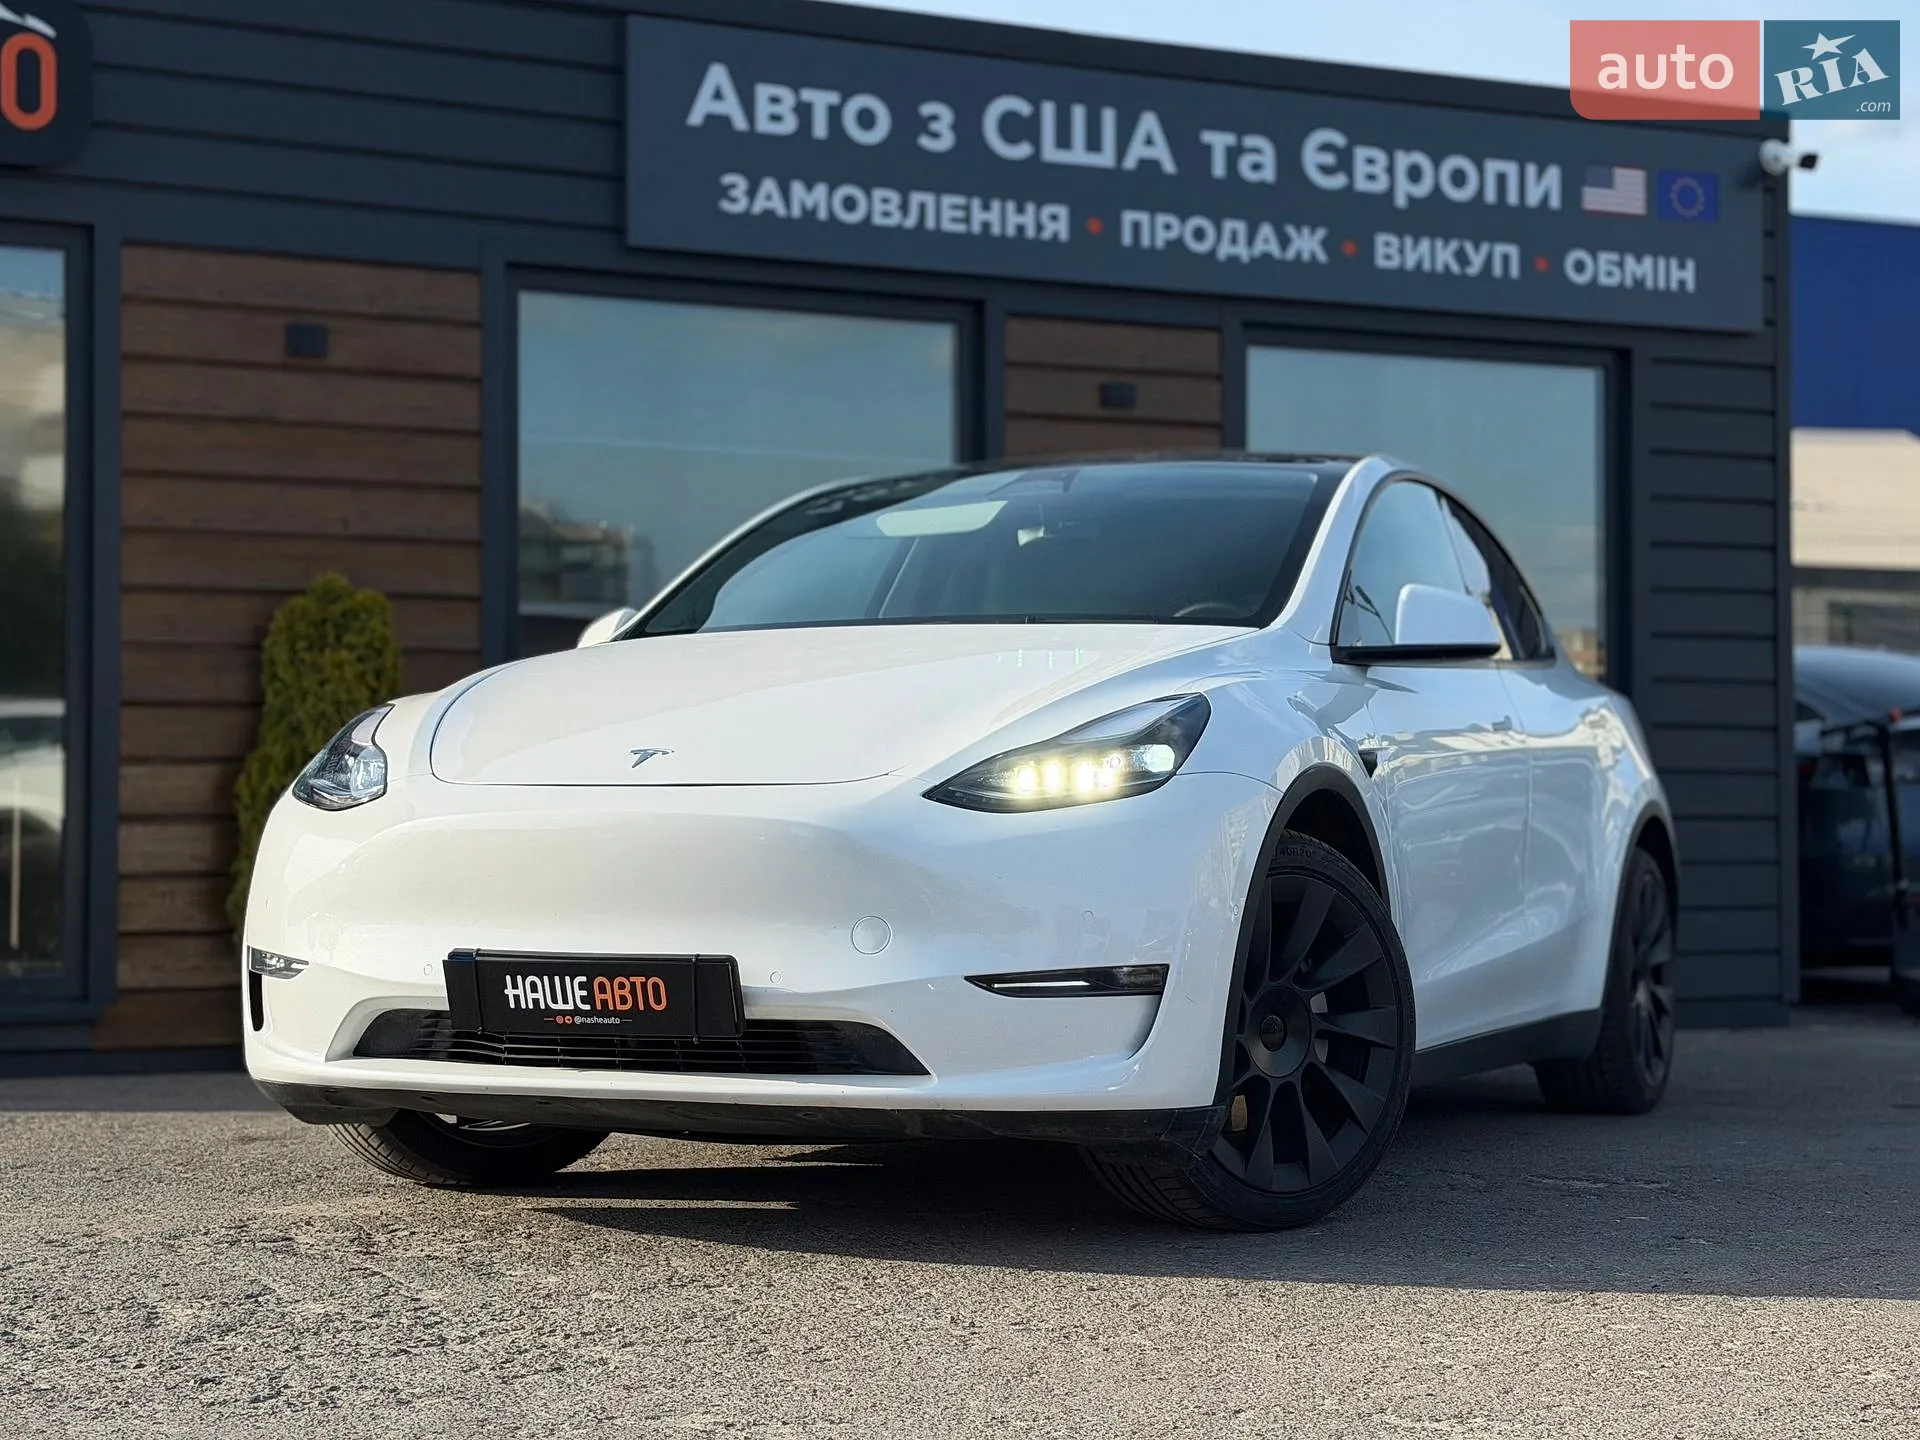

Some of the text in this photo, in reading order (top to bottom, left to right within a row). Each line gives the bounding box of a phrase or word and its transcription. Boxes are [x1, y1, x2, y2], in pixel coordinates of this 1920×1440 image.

[687, 62, 1562, 209] Авто з США та Європи
[719, 173, 1696, 293] ЗАМОВЛЕННЯ ПРОДАЖ ВИКУП ОБМІН
[574, 1015, 621, 1025] @nasheauto
